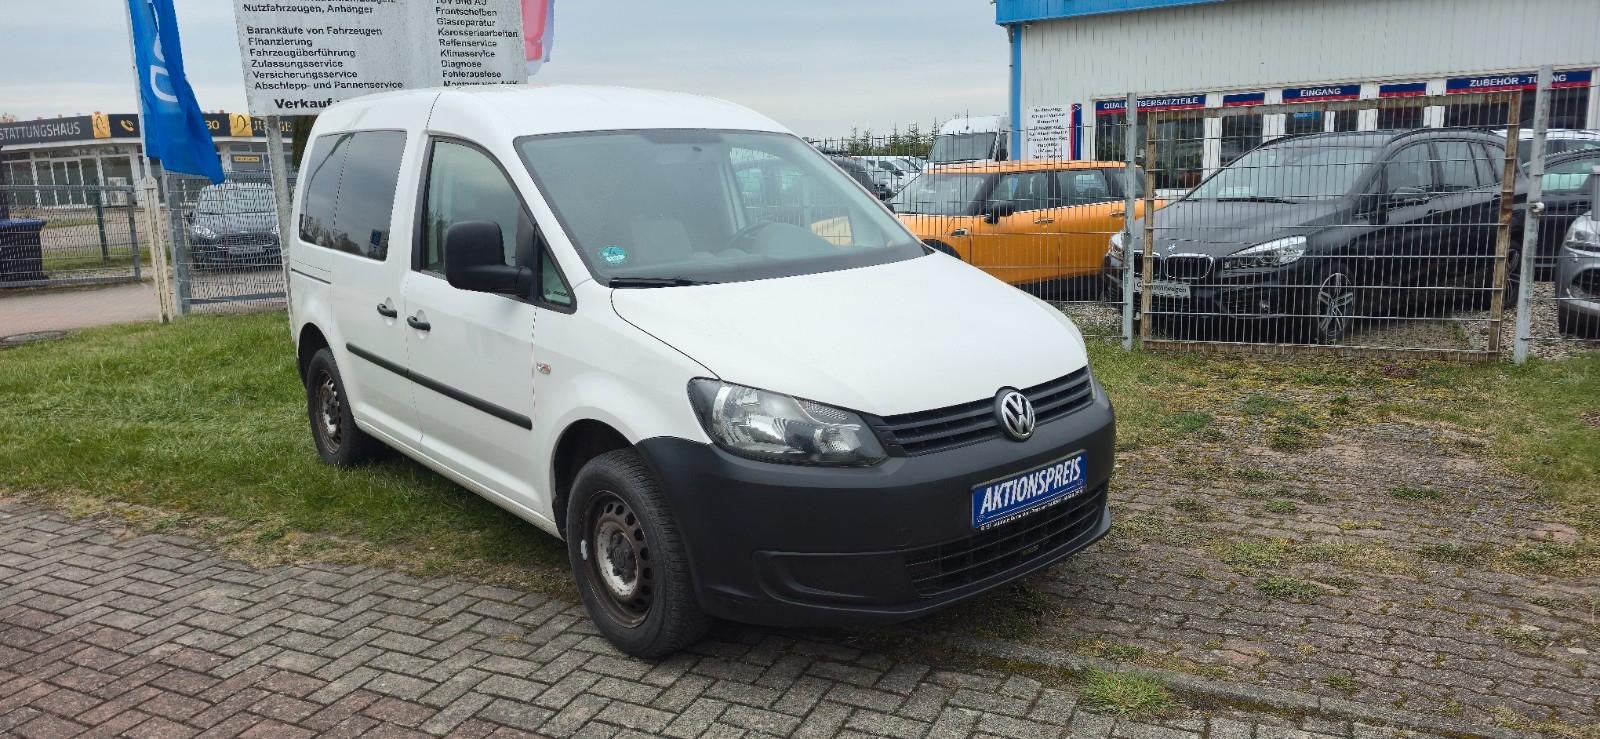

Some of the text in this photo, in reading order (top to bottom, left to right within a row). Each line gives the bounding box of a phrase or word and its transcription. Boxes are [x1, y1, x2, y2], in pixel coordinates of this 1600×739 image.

[243, 3, 374, 15] Nutzfahrzeugen, Anhänger
[435, 6, 498, 16] Frontscheiben
[436, 17, 497, 27] Glasreparatur
[246, 25, 383, 37] Barankäufe von Fahrzeugen
[437, 27, 519, 38] Karosseriearbeiten
[248, 37, 313, 47] Finanzierung
[438, 38, 498, 47] Reifenservice
[249, 48, 356, 58] Fahrzeugüberführung
[440, 49, 497, 58] Klimaservice
[251, 59, 344, 69] Zulassungsservice
[441, 60, 482, 69] Diagnose
[252, 70, 358, 80] Versicherungsservice
[442, 70, 502, 78] Fehlerauslese
[254, 81, 404, 91] Abschlepp- und Pannenservice
[1300, 87, 1342, 97] EINGANG
[274, 98, 333, 109] Verkauf
[979, 455, 1083, 515] AKTIONSPREIS
